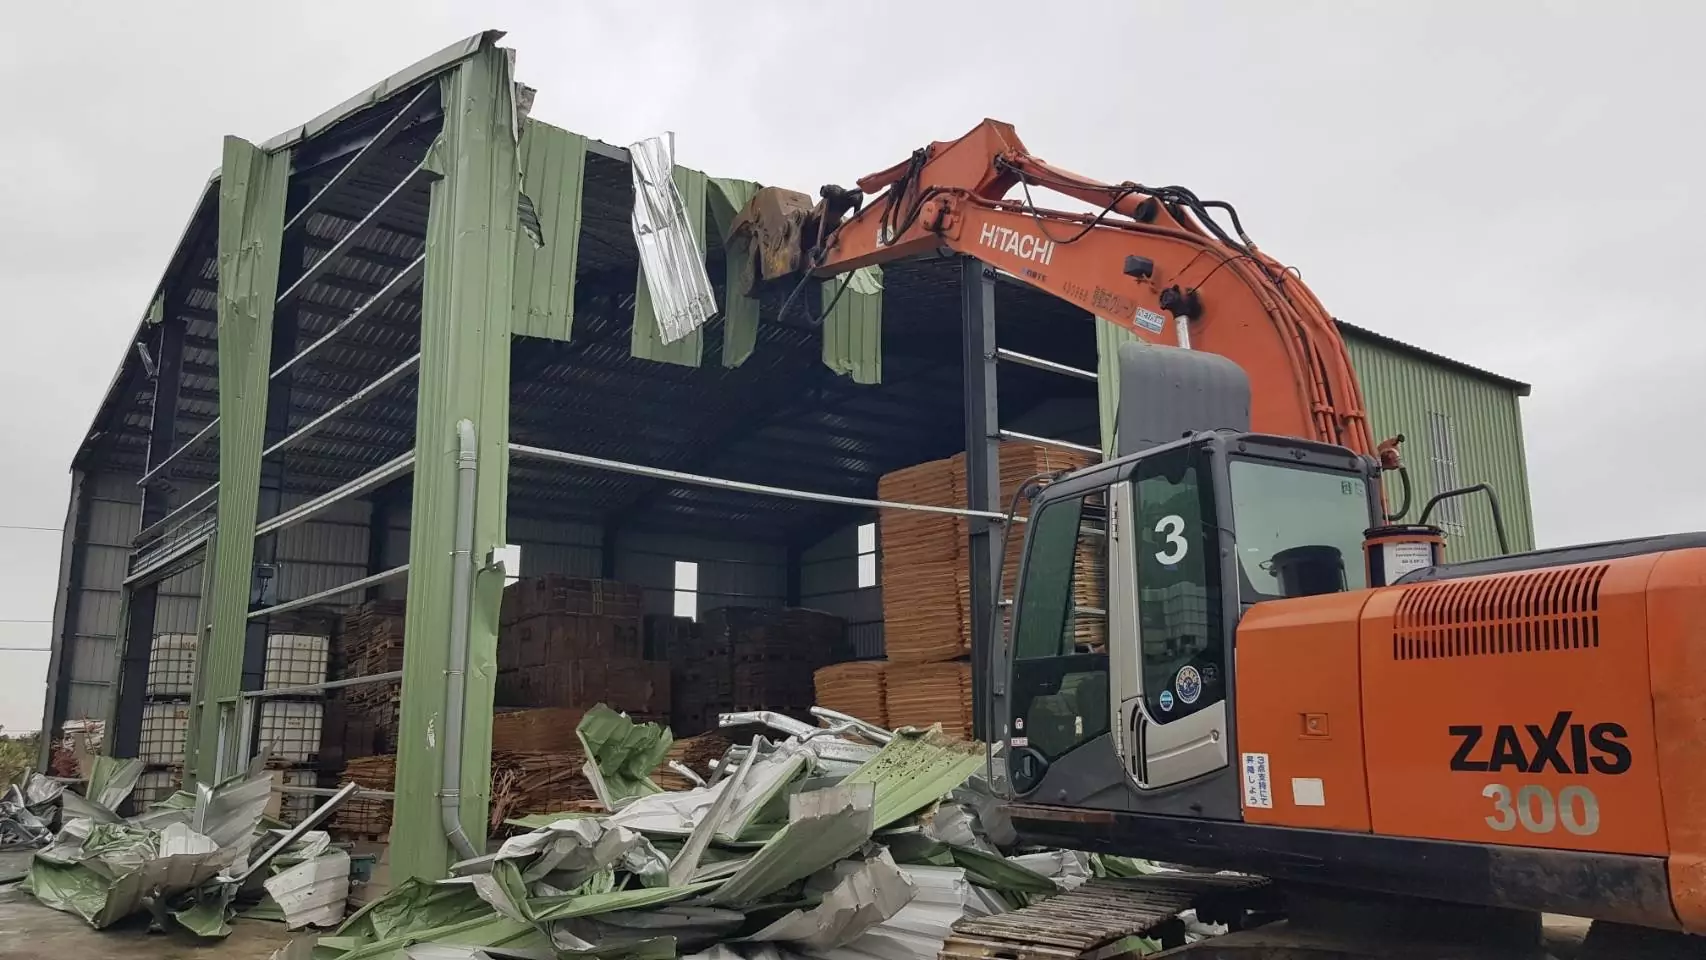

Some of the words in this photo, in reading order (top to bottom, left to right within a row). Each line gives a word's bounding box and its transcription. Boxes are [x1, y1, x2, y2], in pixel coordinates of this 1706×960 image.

[979, 222, 1055, 266] HITACHI
[1154, 514, 1188, 565] 3
[1449, 711, 1632, 775] ZAXIS
[1482, 784, 1600, 836] 300
